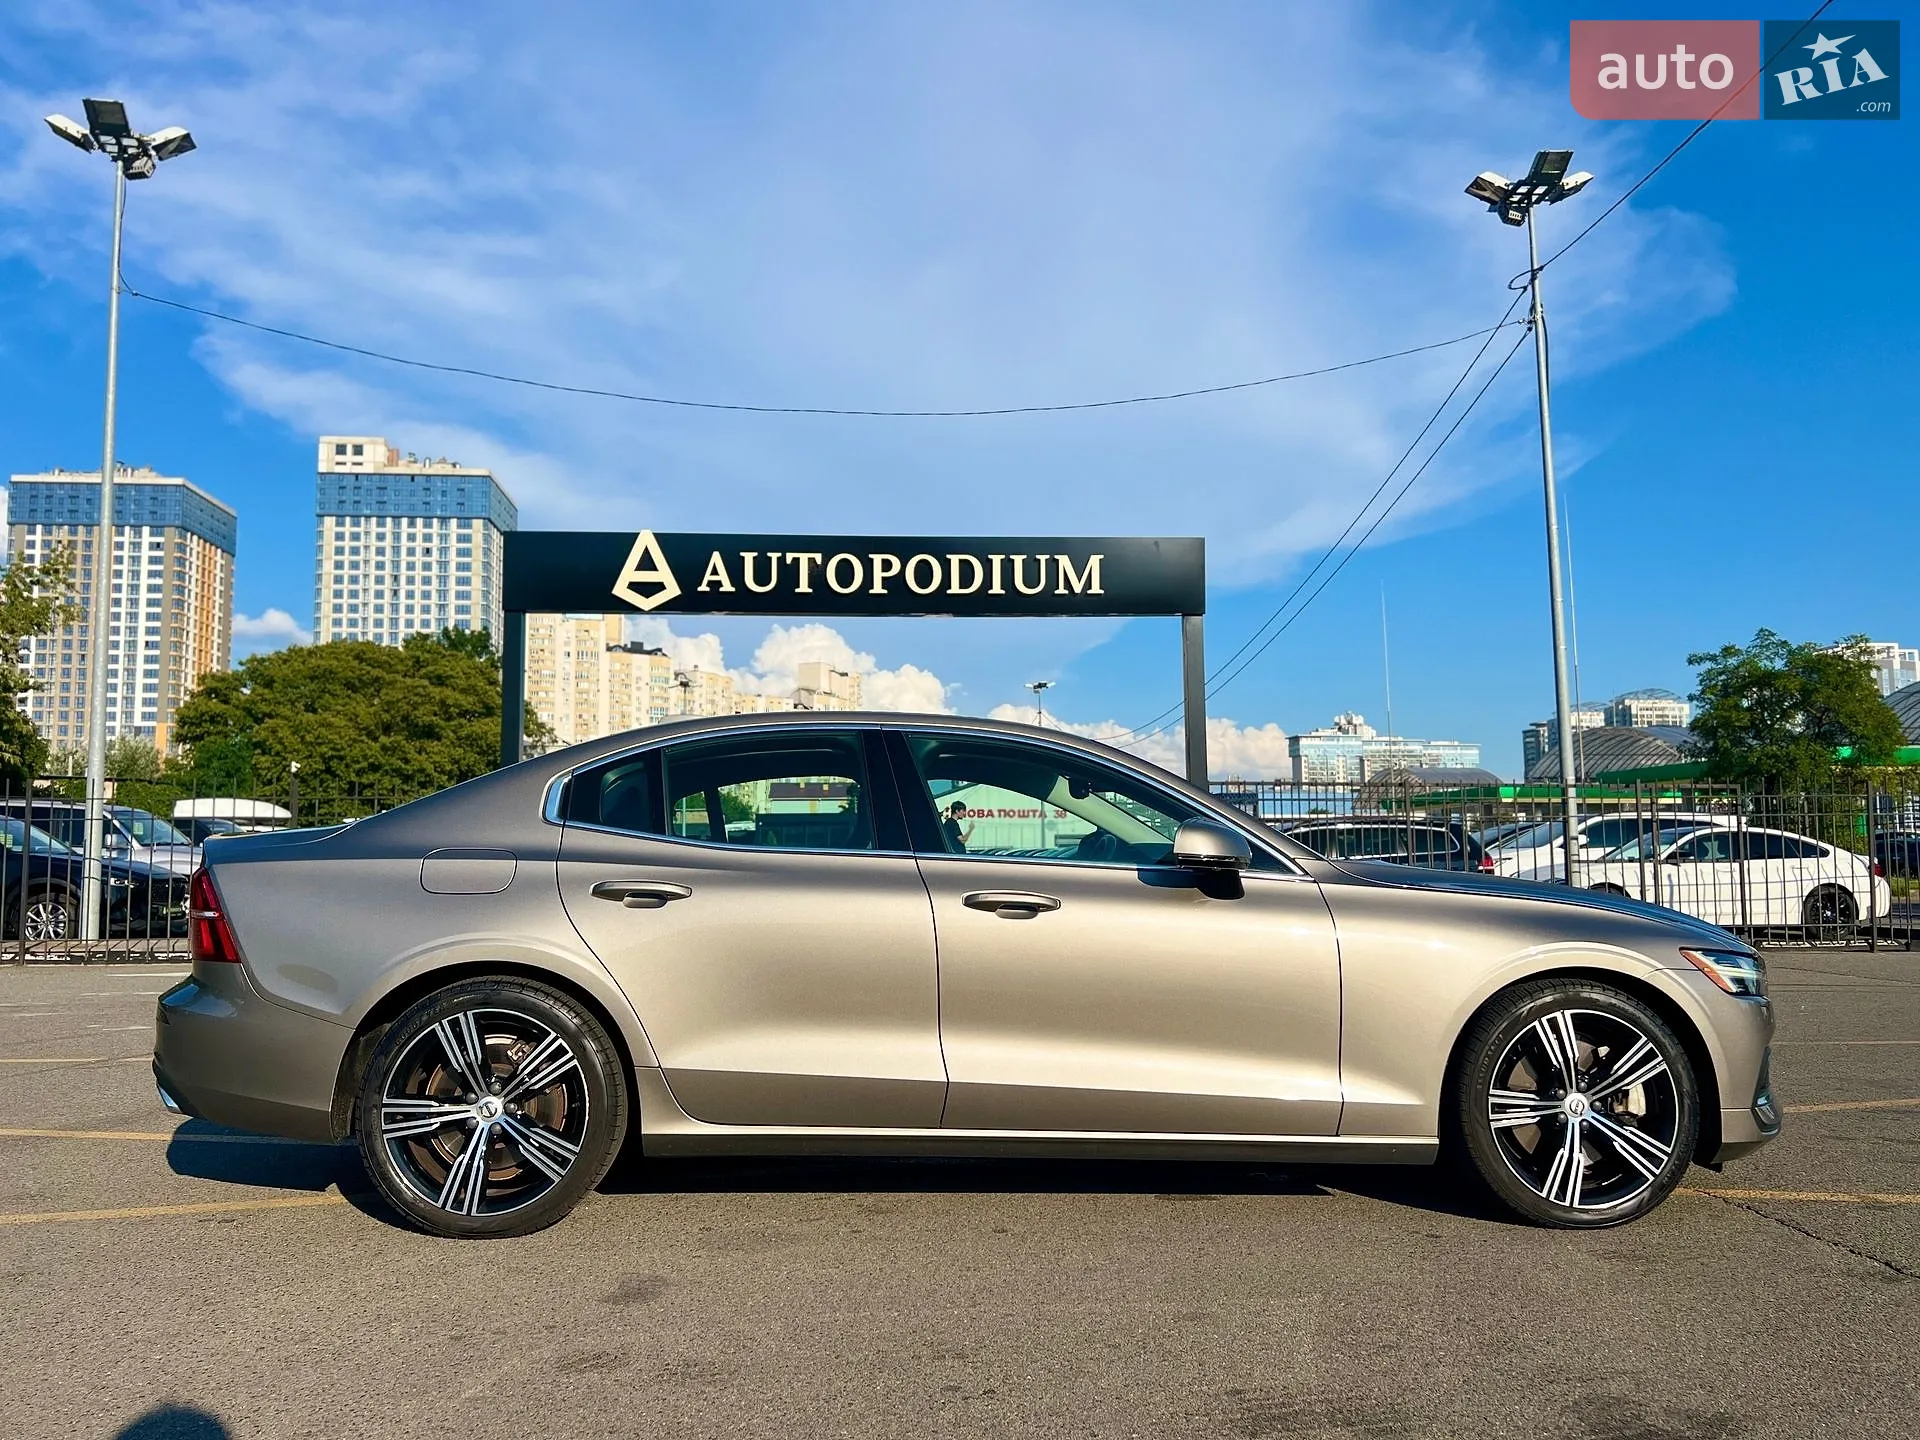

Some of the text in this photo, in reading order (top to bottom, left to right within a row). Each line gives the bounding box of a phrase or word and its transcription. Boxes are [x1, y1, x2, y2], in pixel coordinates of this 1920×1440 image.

[697, 551, 1105, 595] AUTOPODIUM
[962, 808, 995, 819] ОВА
[997, 808, 1048, 819] ПОШТА
